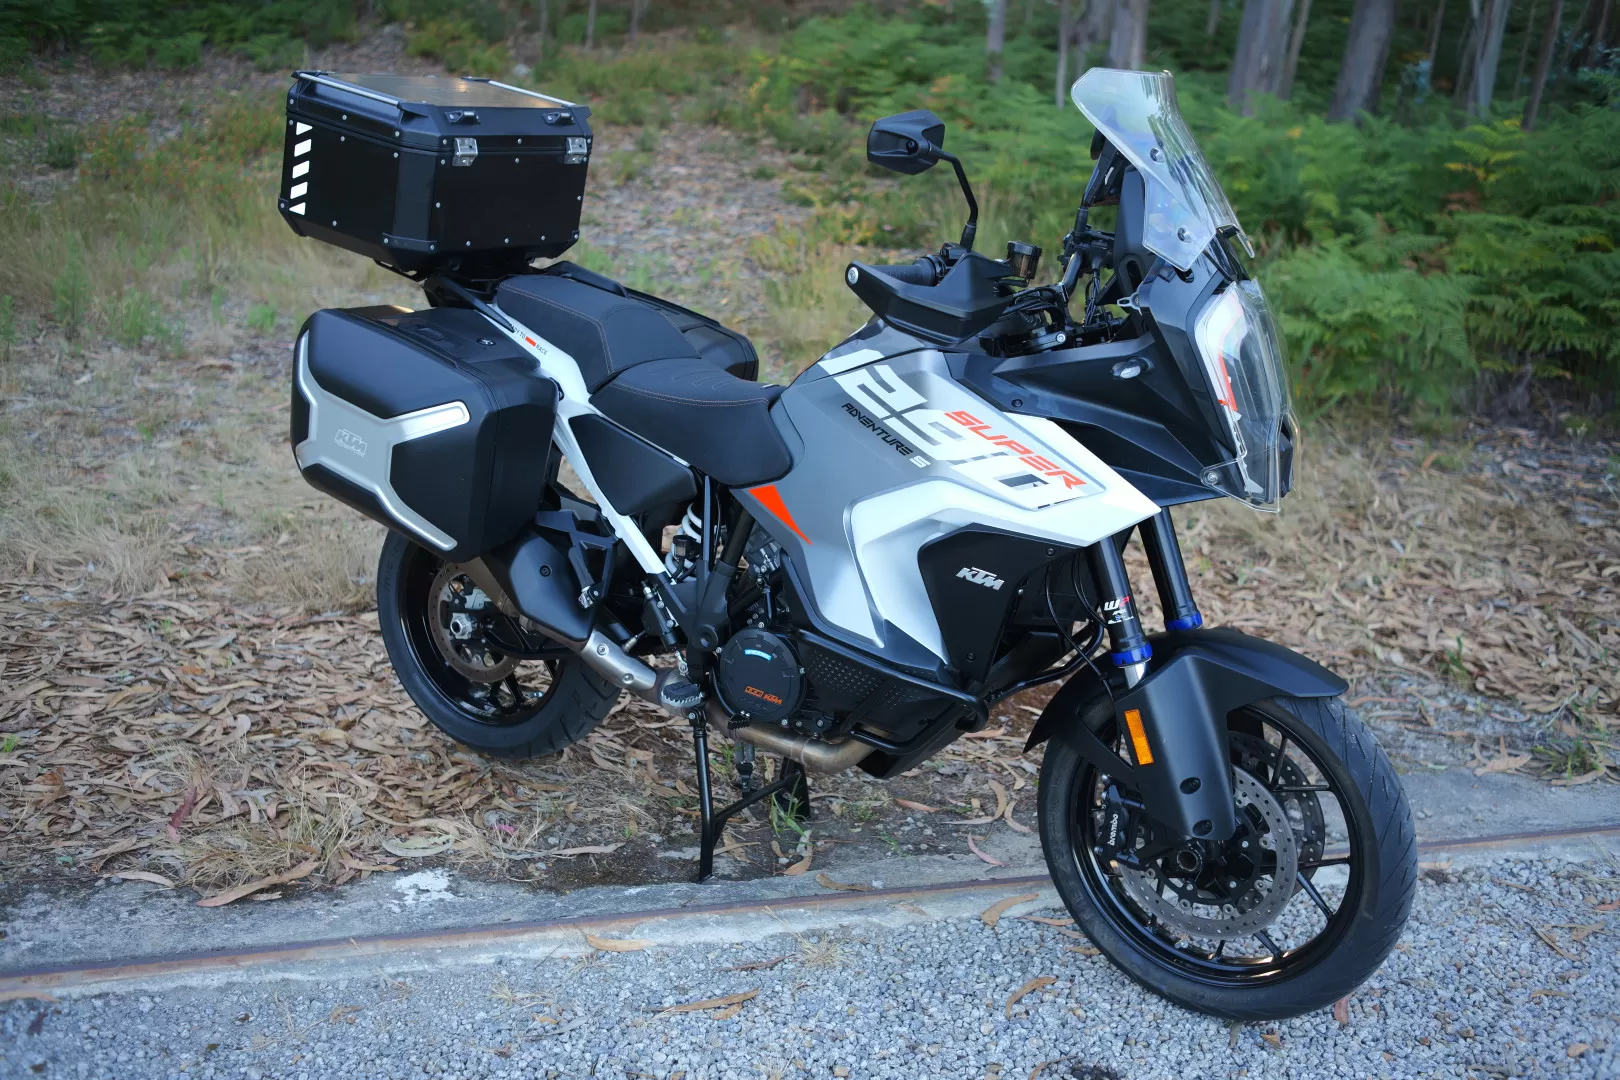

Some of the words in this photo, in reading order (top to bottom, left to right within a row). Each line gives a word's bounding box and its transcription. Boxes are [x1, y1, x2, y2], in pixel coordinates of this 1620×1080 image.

[334, 428, 368, 455] KTM
[841, 402, 914, 456] ADVENTURE
[909, 455, 931, 468] S
[943, 410, 1088, 490] SUPER
[955, 566, 1005, 590] KTM
[1103, 596, 1130, 611] WP
[1107, 813, 1119, 846] brembo
